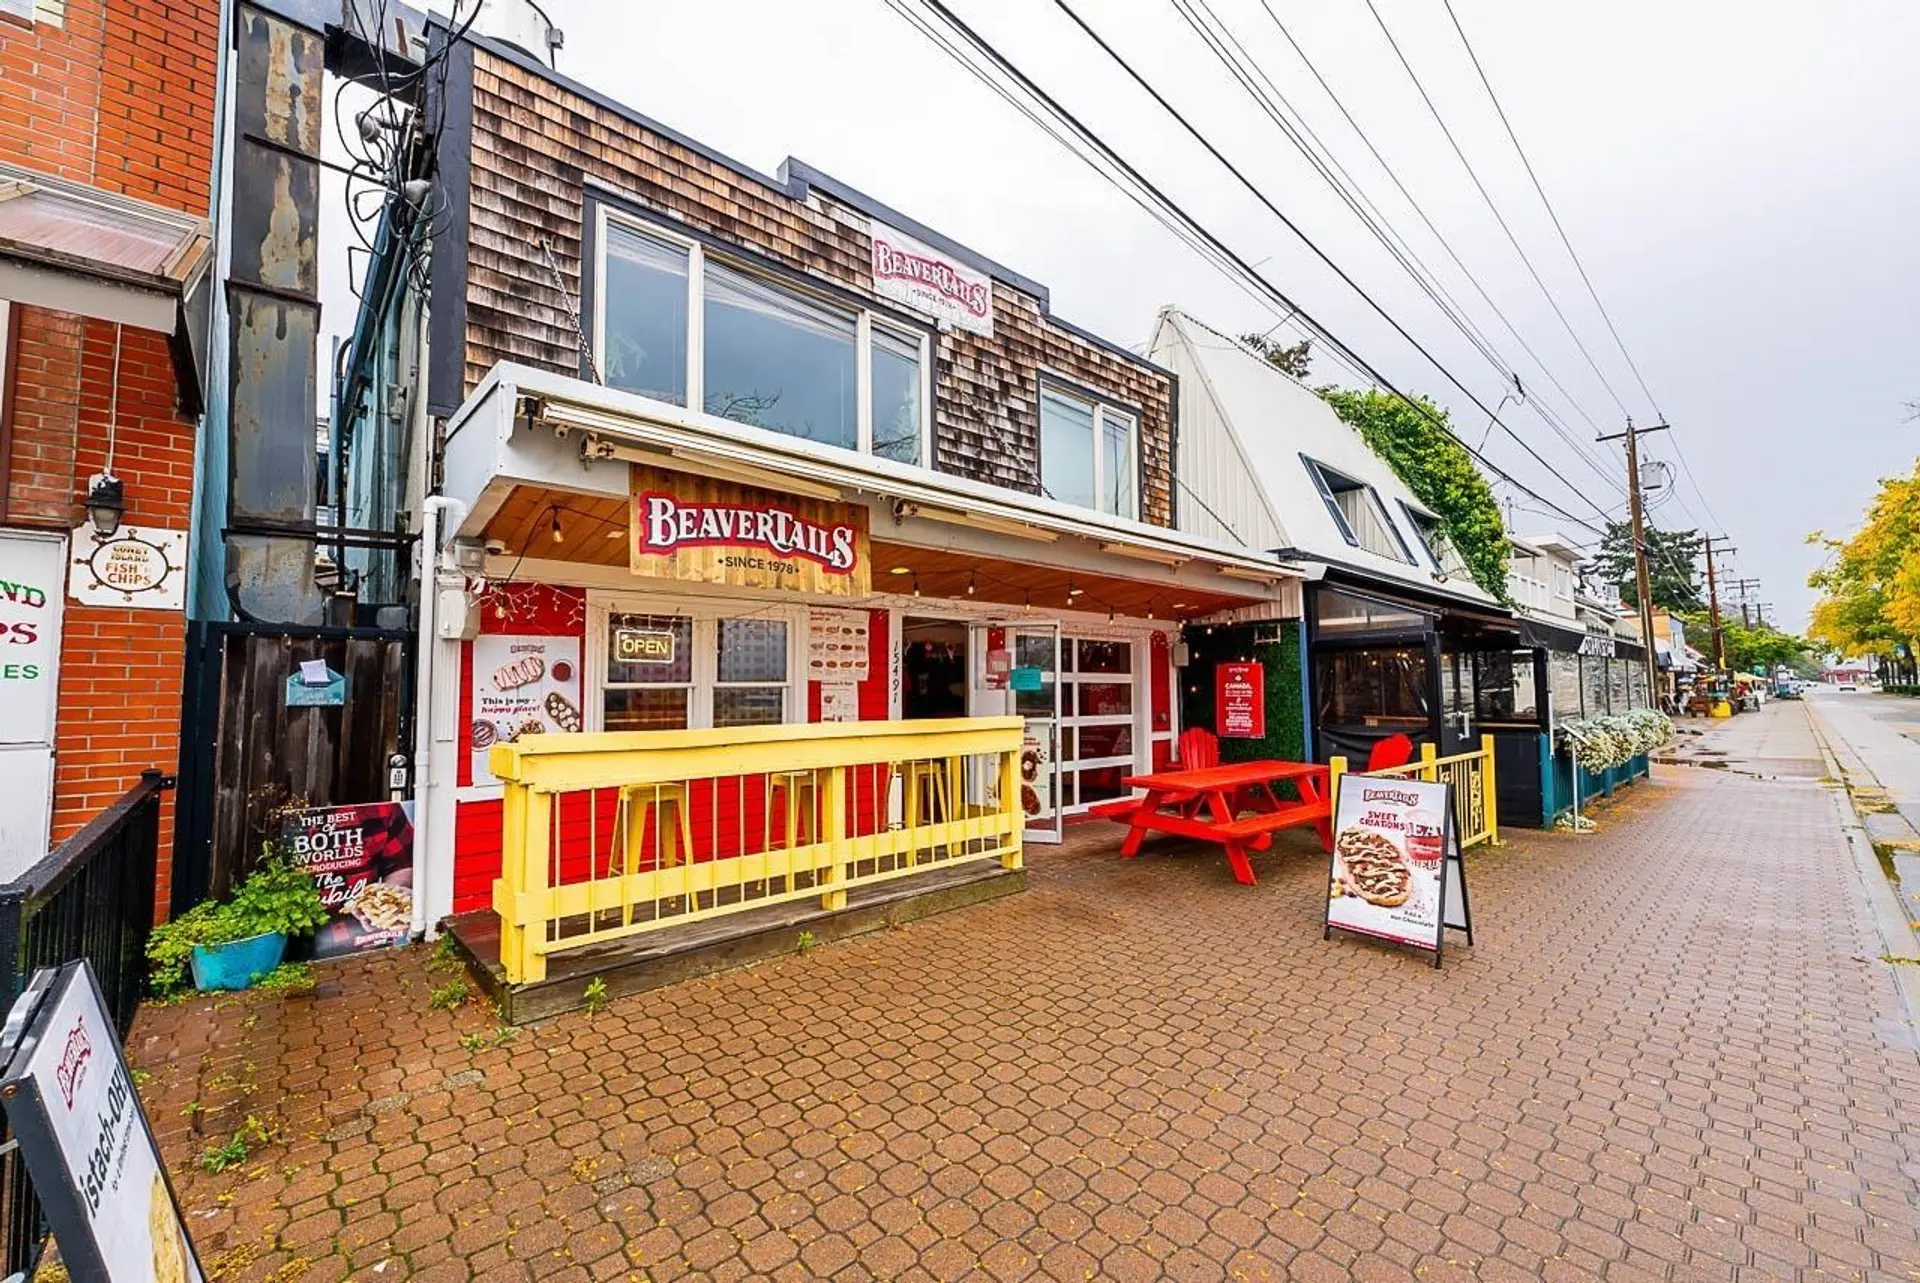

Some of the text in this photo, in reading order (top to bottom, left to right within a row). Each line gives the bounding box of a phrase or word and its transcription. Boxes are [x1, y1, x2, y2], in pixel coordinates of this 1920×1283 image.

[647, 497, 854, 569] BEAVERTAILS
[725, 556, 794, 574] SINCE 1978
[622, 639, 668, 654] OPEN
[300, 811, 356, 827] THE BEST
[296, 828, 363, 853] BOTH
[297, 846, 364, 864] WORLDS
[315, 871, 342, 888] The
